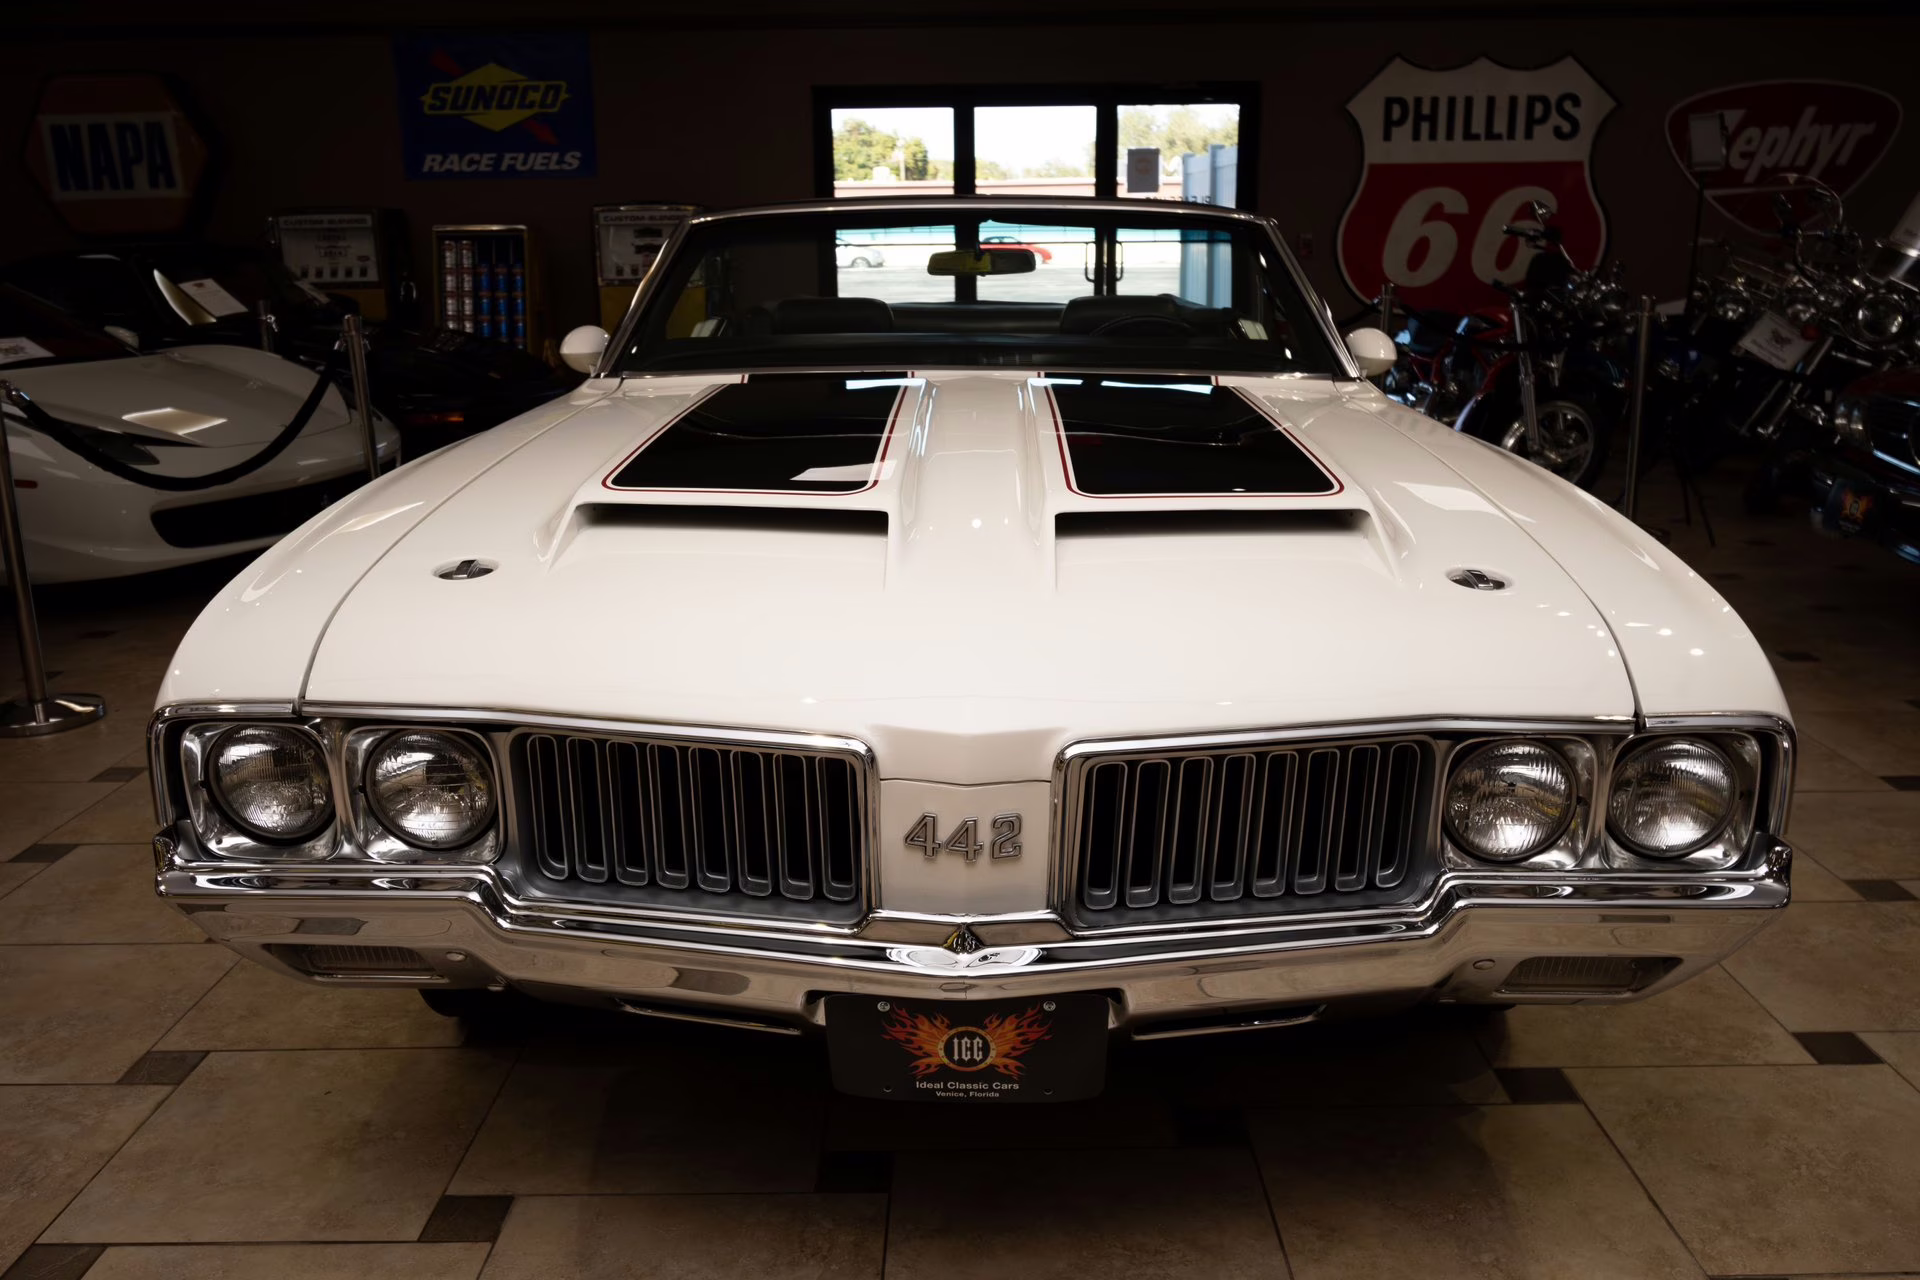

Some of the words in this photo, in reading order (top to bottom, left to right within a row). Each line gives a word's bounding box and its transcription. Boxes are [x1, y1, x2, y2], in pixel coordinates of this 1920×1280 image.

[428, 83, 563, 113] SUNOCO
[1382, 93, 1581, 141] PHILLIPS
[51, 122, 176, 190] NAPA
[422, 153, 497, 172] RACE
[500, 151, 582, 171] FUELS
[1381, 185, 1559, 288] 66
[904, 812, 1023, 862] 442
[916, 1081, 944, 1089] Ideal
[947, 1081, 989, 1090] Classic
[992, 1082, 1019, 1090] Cars
